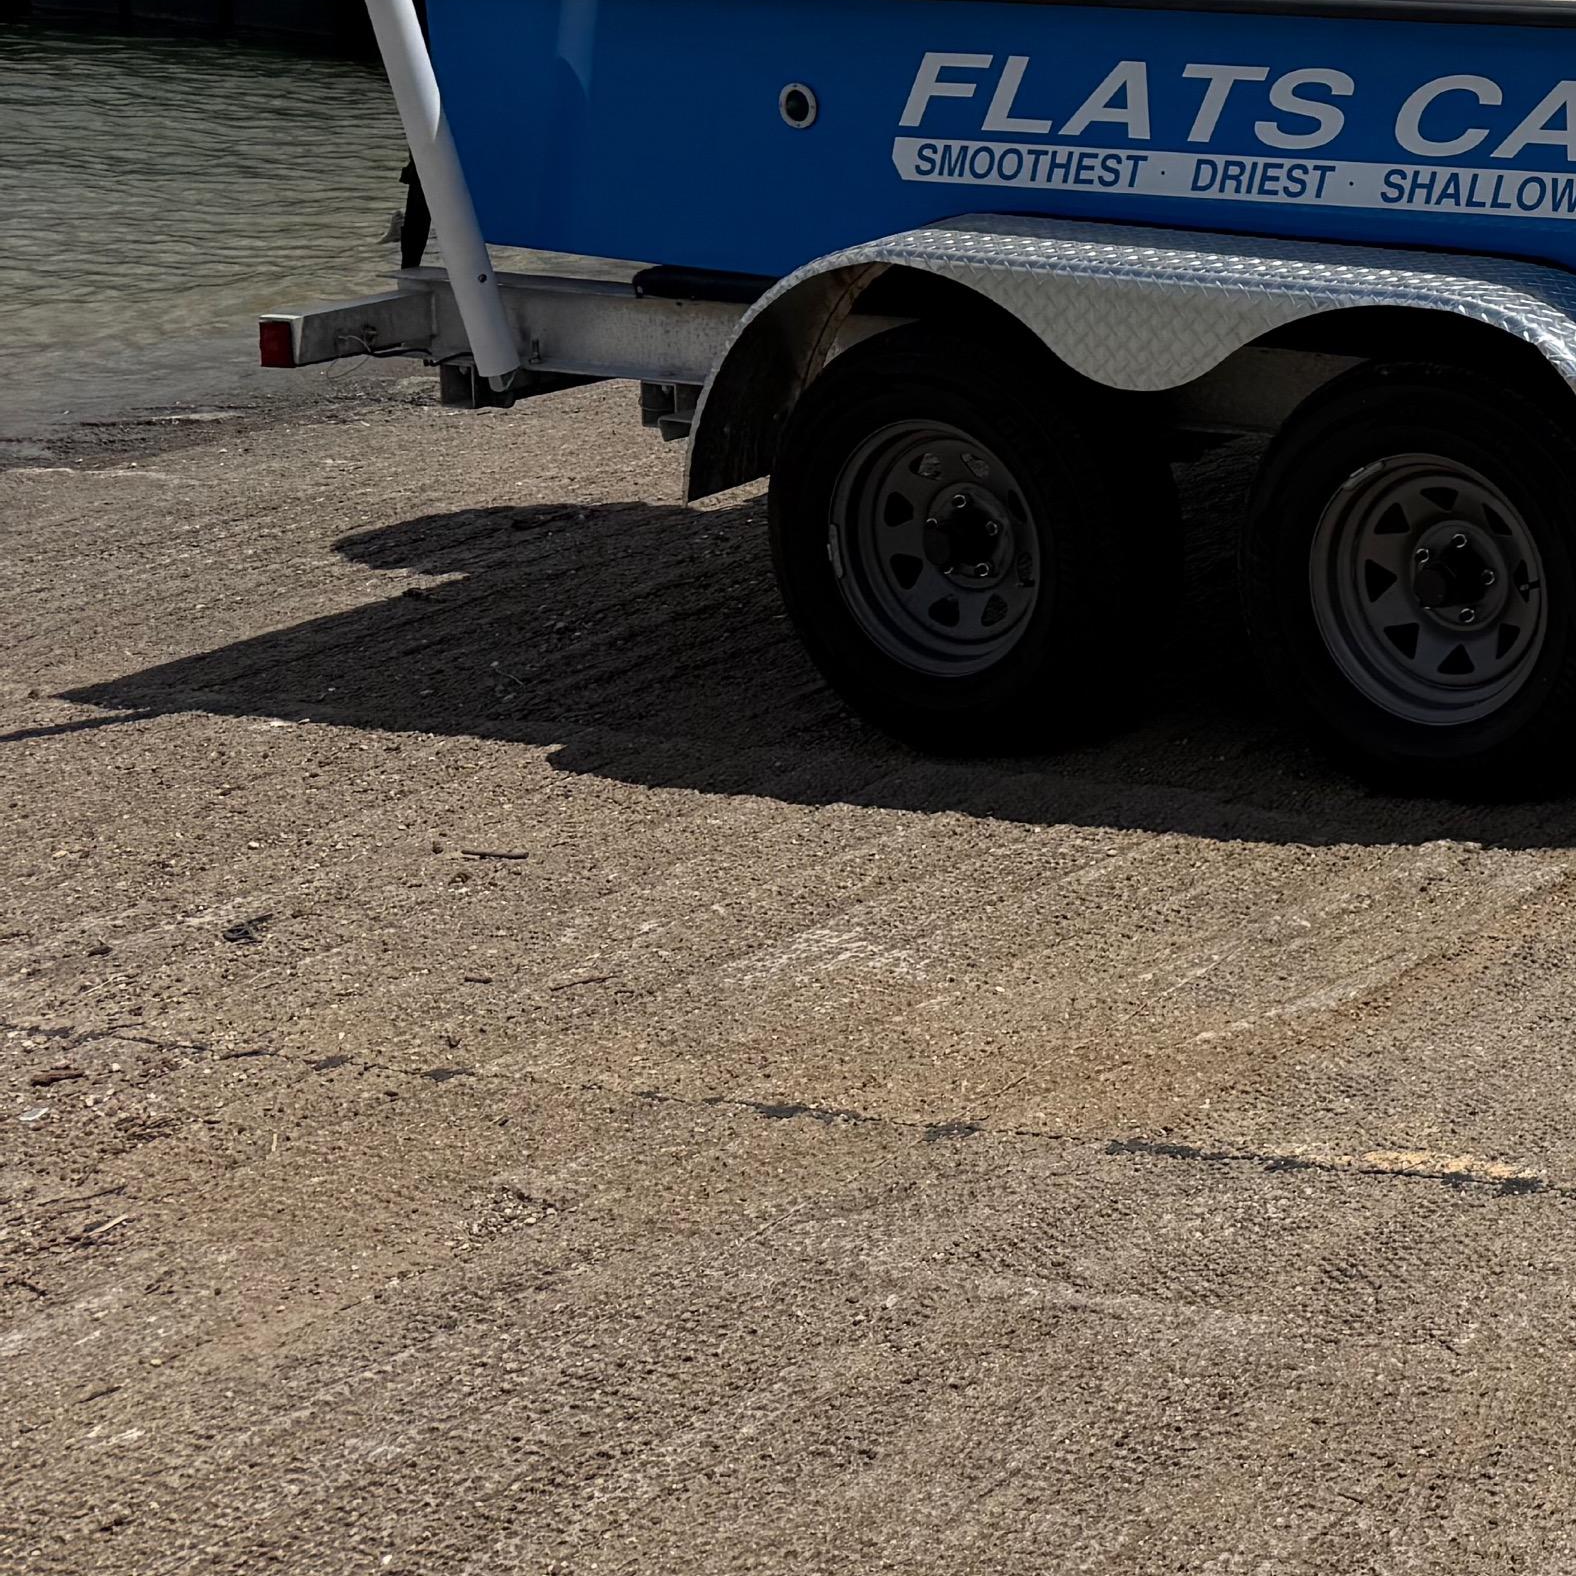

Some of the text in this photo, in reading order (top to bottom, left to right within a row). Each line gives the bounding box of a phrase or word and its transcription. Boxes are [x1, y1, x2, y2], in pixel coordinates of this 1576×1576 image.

[898, 52, 1355, 150] FLATS
[914, 143, 1148, 188] SMOOTHEST
[1190, 159, 1336, 199] DRIEST
